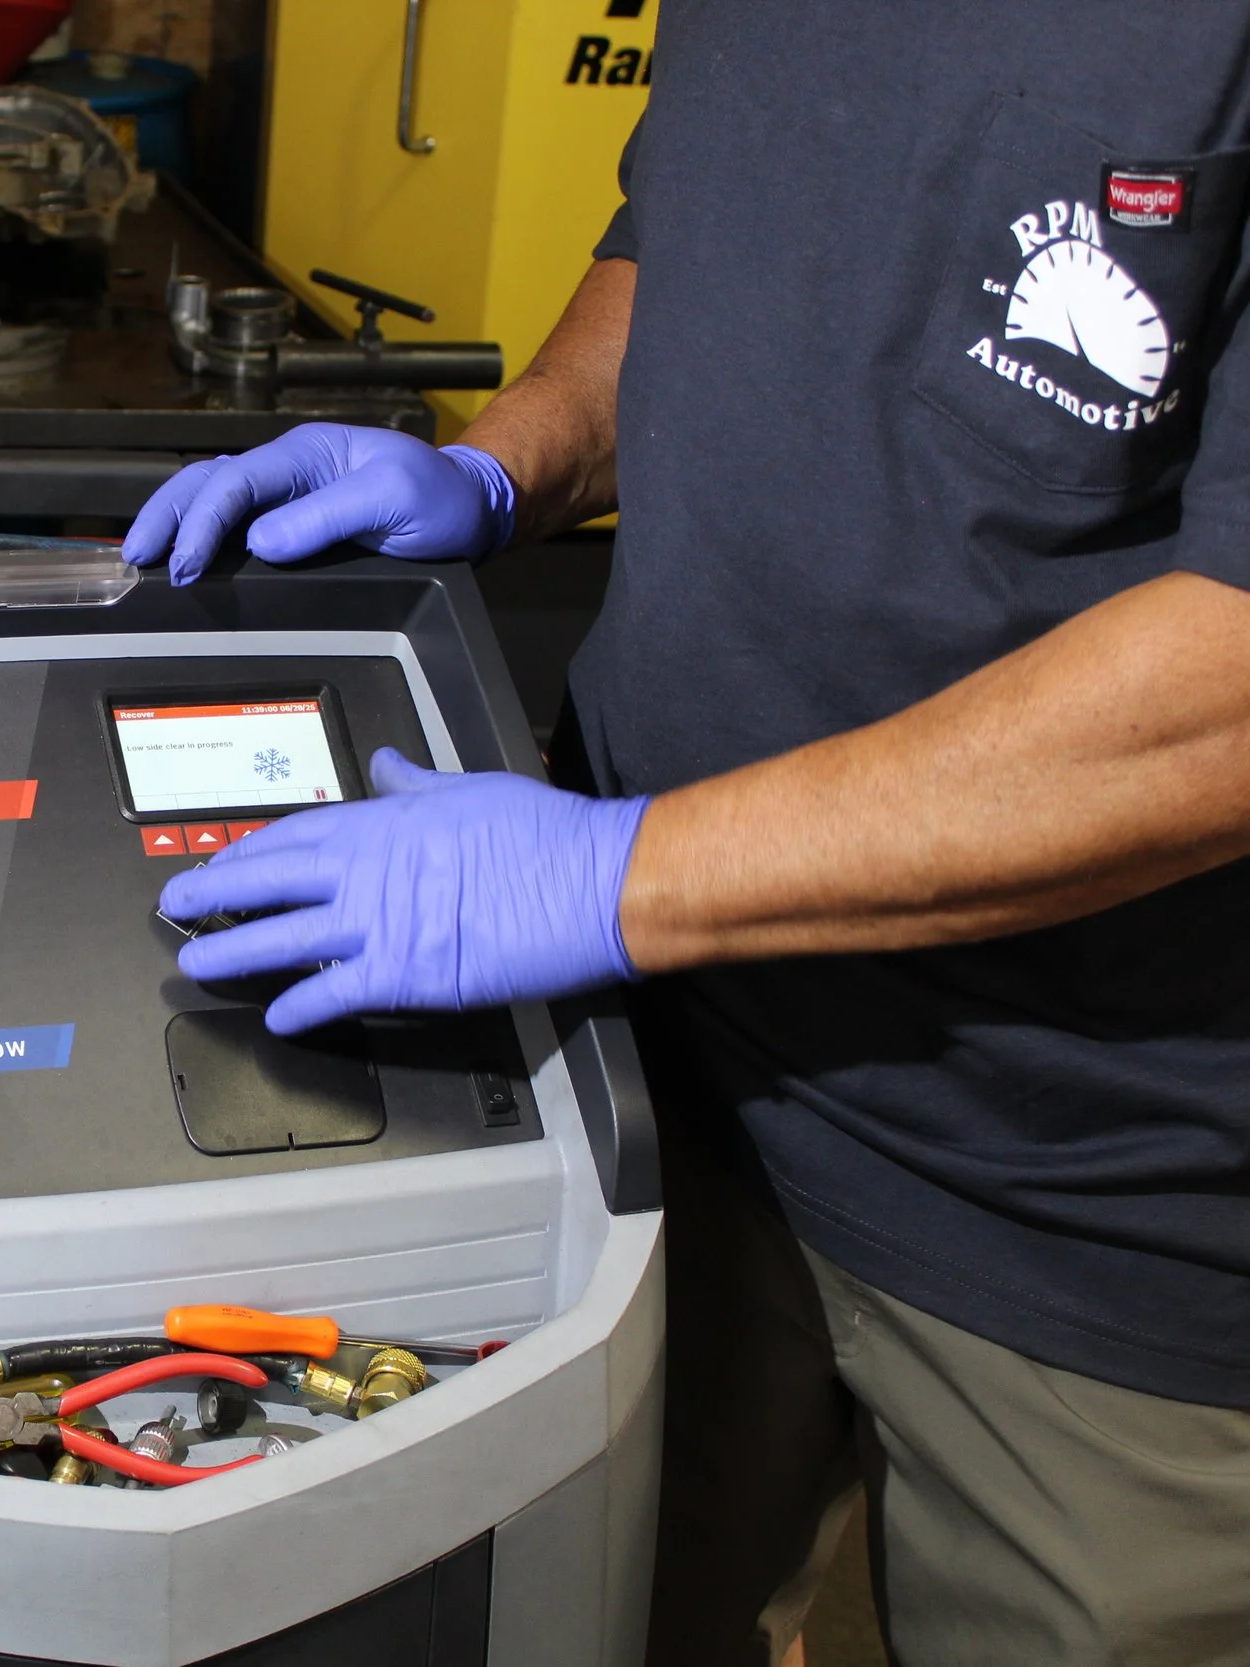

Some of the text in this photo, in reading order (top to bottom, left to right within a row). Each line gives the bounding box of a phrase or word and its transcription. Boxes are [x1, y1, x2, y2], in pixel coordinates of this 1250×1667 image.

[1110, 183, 1176, 213] Wrangler
[1010, 201, 1102, 257] RPM
[982, 279, 1006, 296] Est
[966, 337, 1180, 431] Automotive
[120, 711, 155, 719] Recover
[146, 743, 163, 751] side
[165, 742, 185, 750] clear
[187, 741, 195, 749] in
[197, 740, 233, 749] progress
